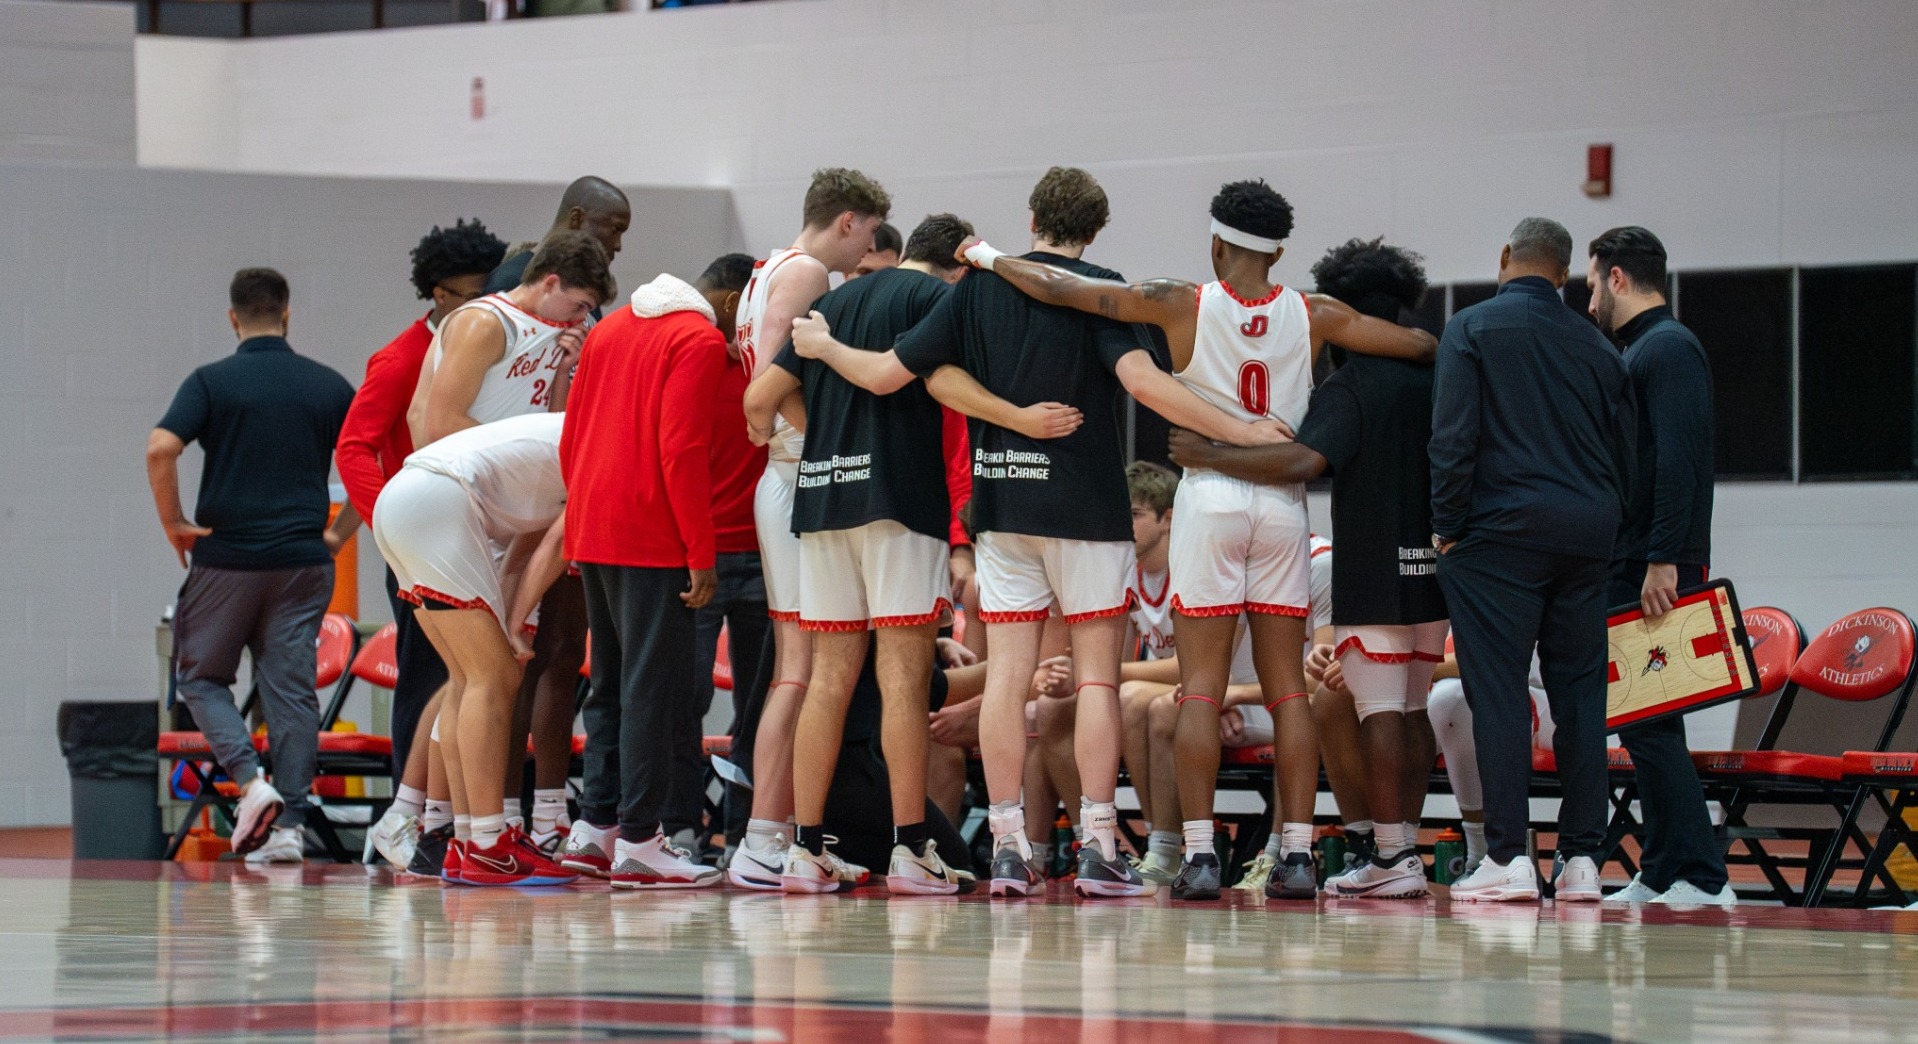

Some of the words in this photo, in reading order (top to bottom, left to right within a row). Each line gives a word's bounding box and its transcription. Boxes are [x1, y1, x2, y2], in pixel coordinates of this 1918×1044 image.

[505, 347, 547, 379] Red
[1237, 360, 1270, 417] 0
[831, 453, 871, 468] BARRIERS
[1005, 449, 1051, 465] BARRIERS
[834, 467, 871, 483] CHANGE
[1007, 465, 1050, 480] CHANGE
[1742, 613, 1783, 636] KINSON
[1827, 613, 1898, 638] DICKINSON
[1819, 662, 1885, 686] ATHLETICS
